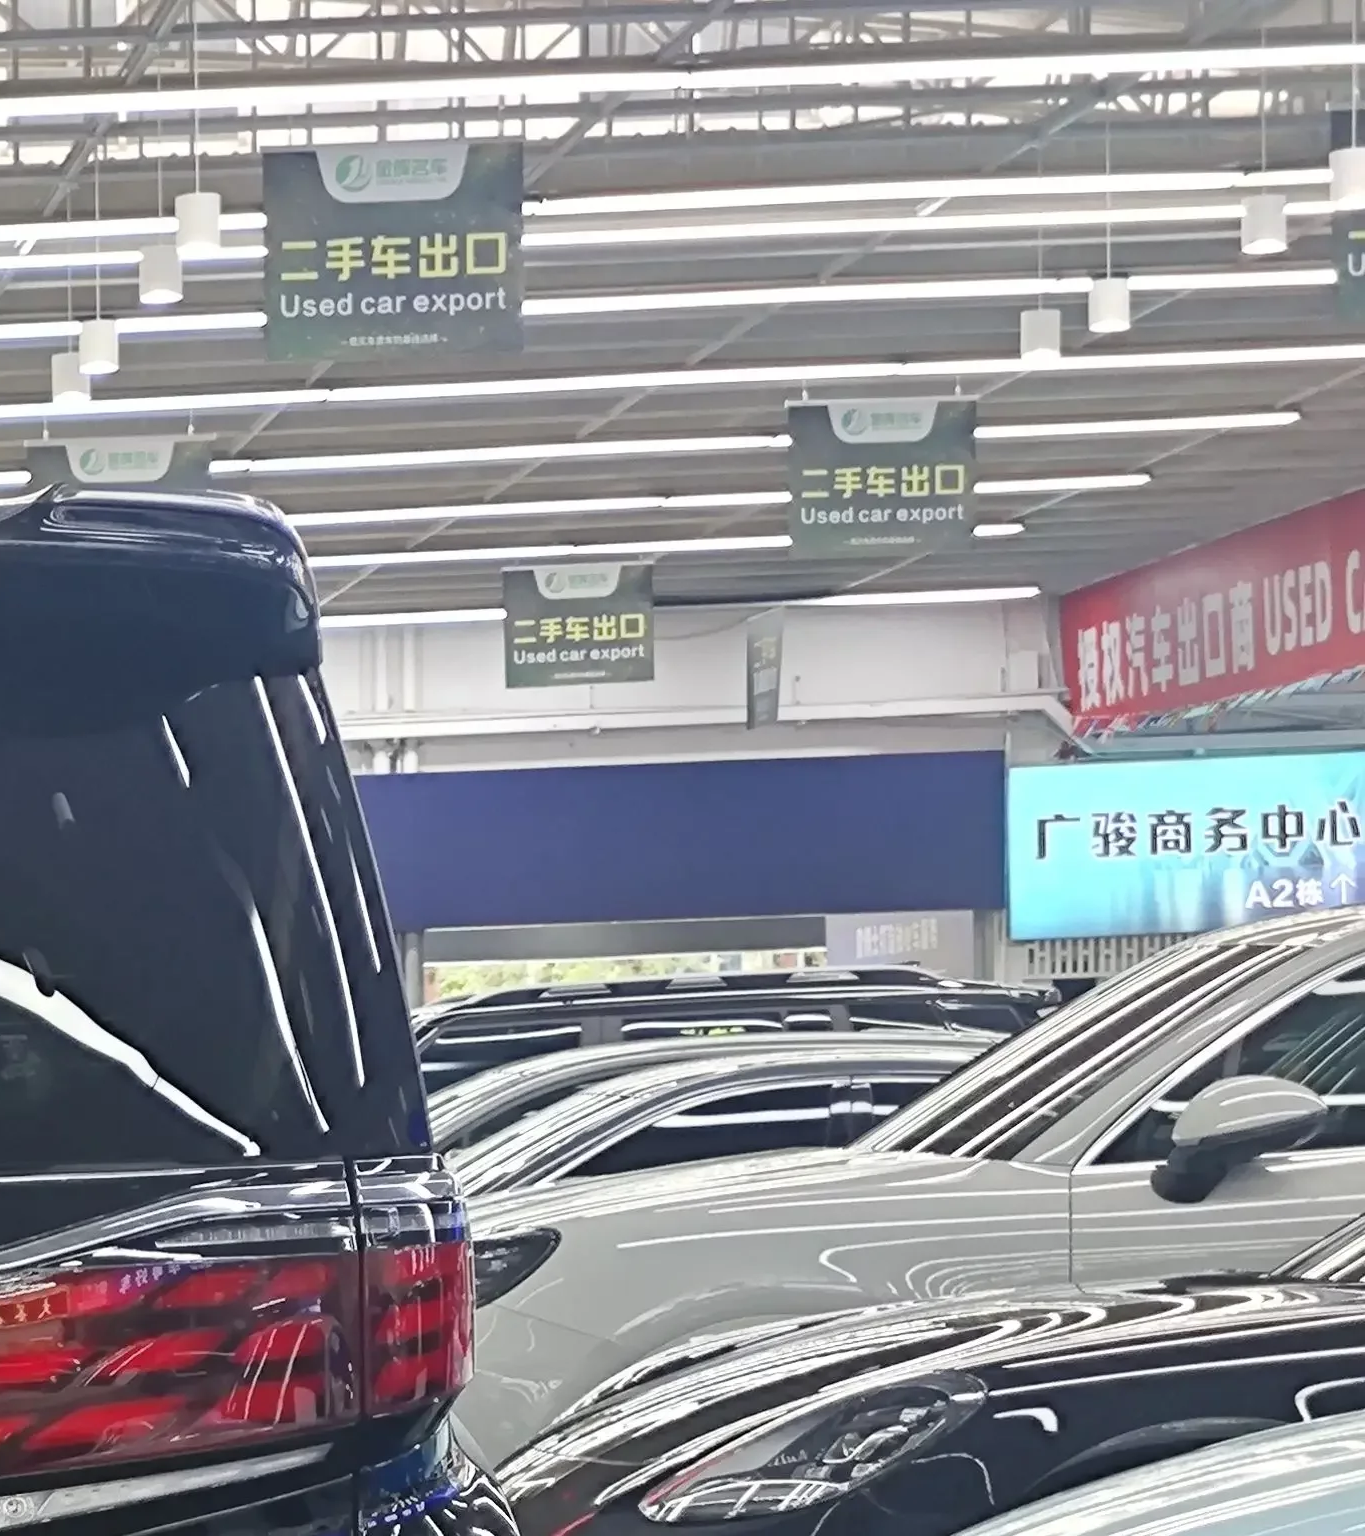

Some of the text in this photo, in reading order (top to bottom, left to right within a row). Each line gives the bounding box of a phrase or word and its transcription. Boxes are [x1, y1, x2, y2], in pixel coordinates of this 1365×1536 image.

[280, 232, 507, 281] 二手车出口
[280, 287, 506, 318] Used car export
[802, 464, 965, 498] 二手车出口
[801, 503, 965, 525] Used car export
[513, 613, 645, 643] 二手车出口
[1077, 579, 1256, 712] 授权汽车出口商
[1263, 560, 1332, 656] USED
[513, 644, 645, 664] Used car export
[1035, 800, 1361, 860] 广骏商务中心
[1245, 877, 1325, 909] A2栋
